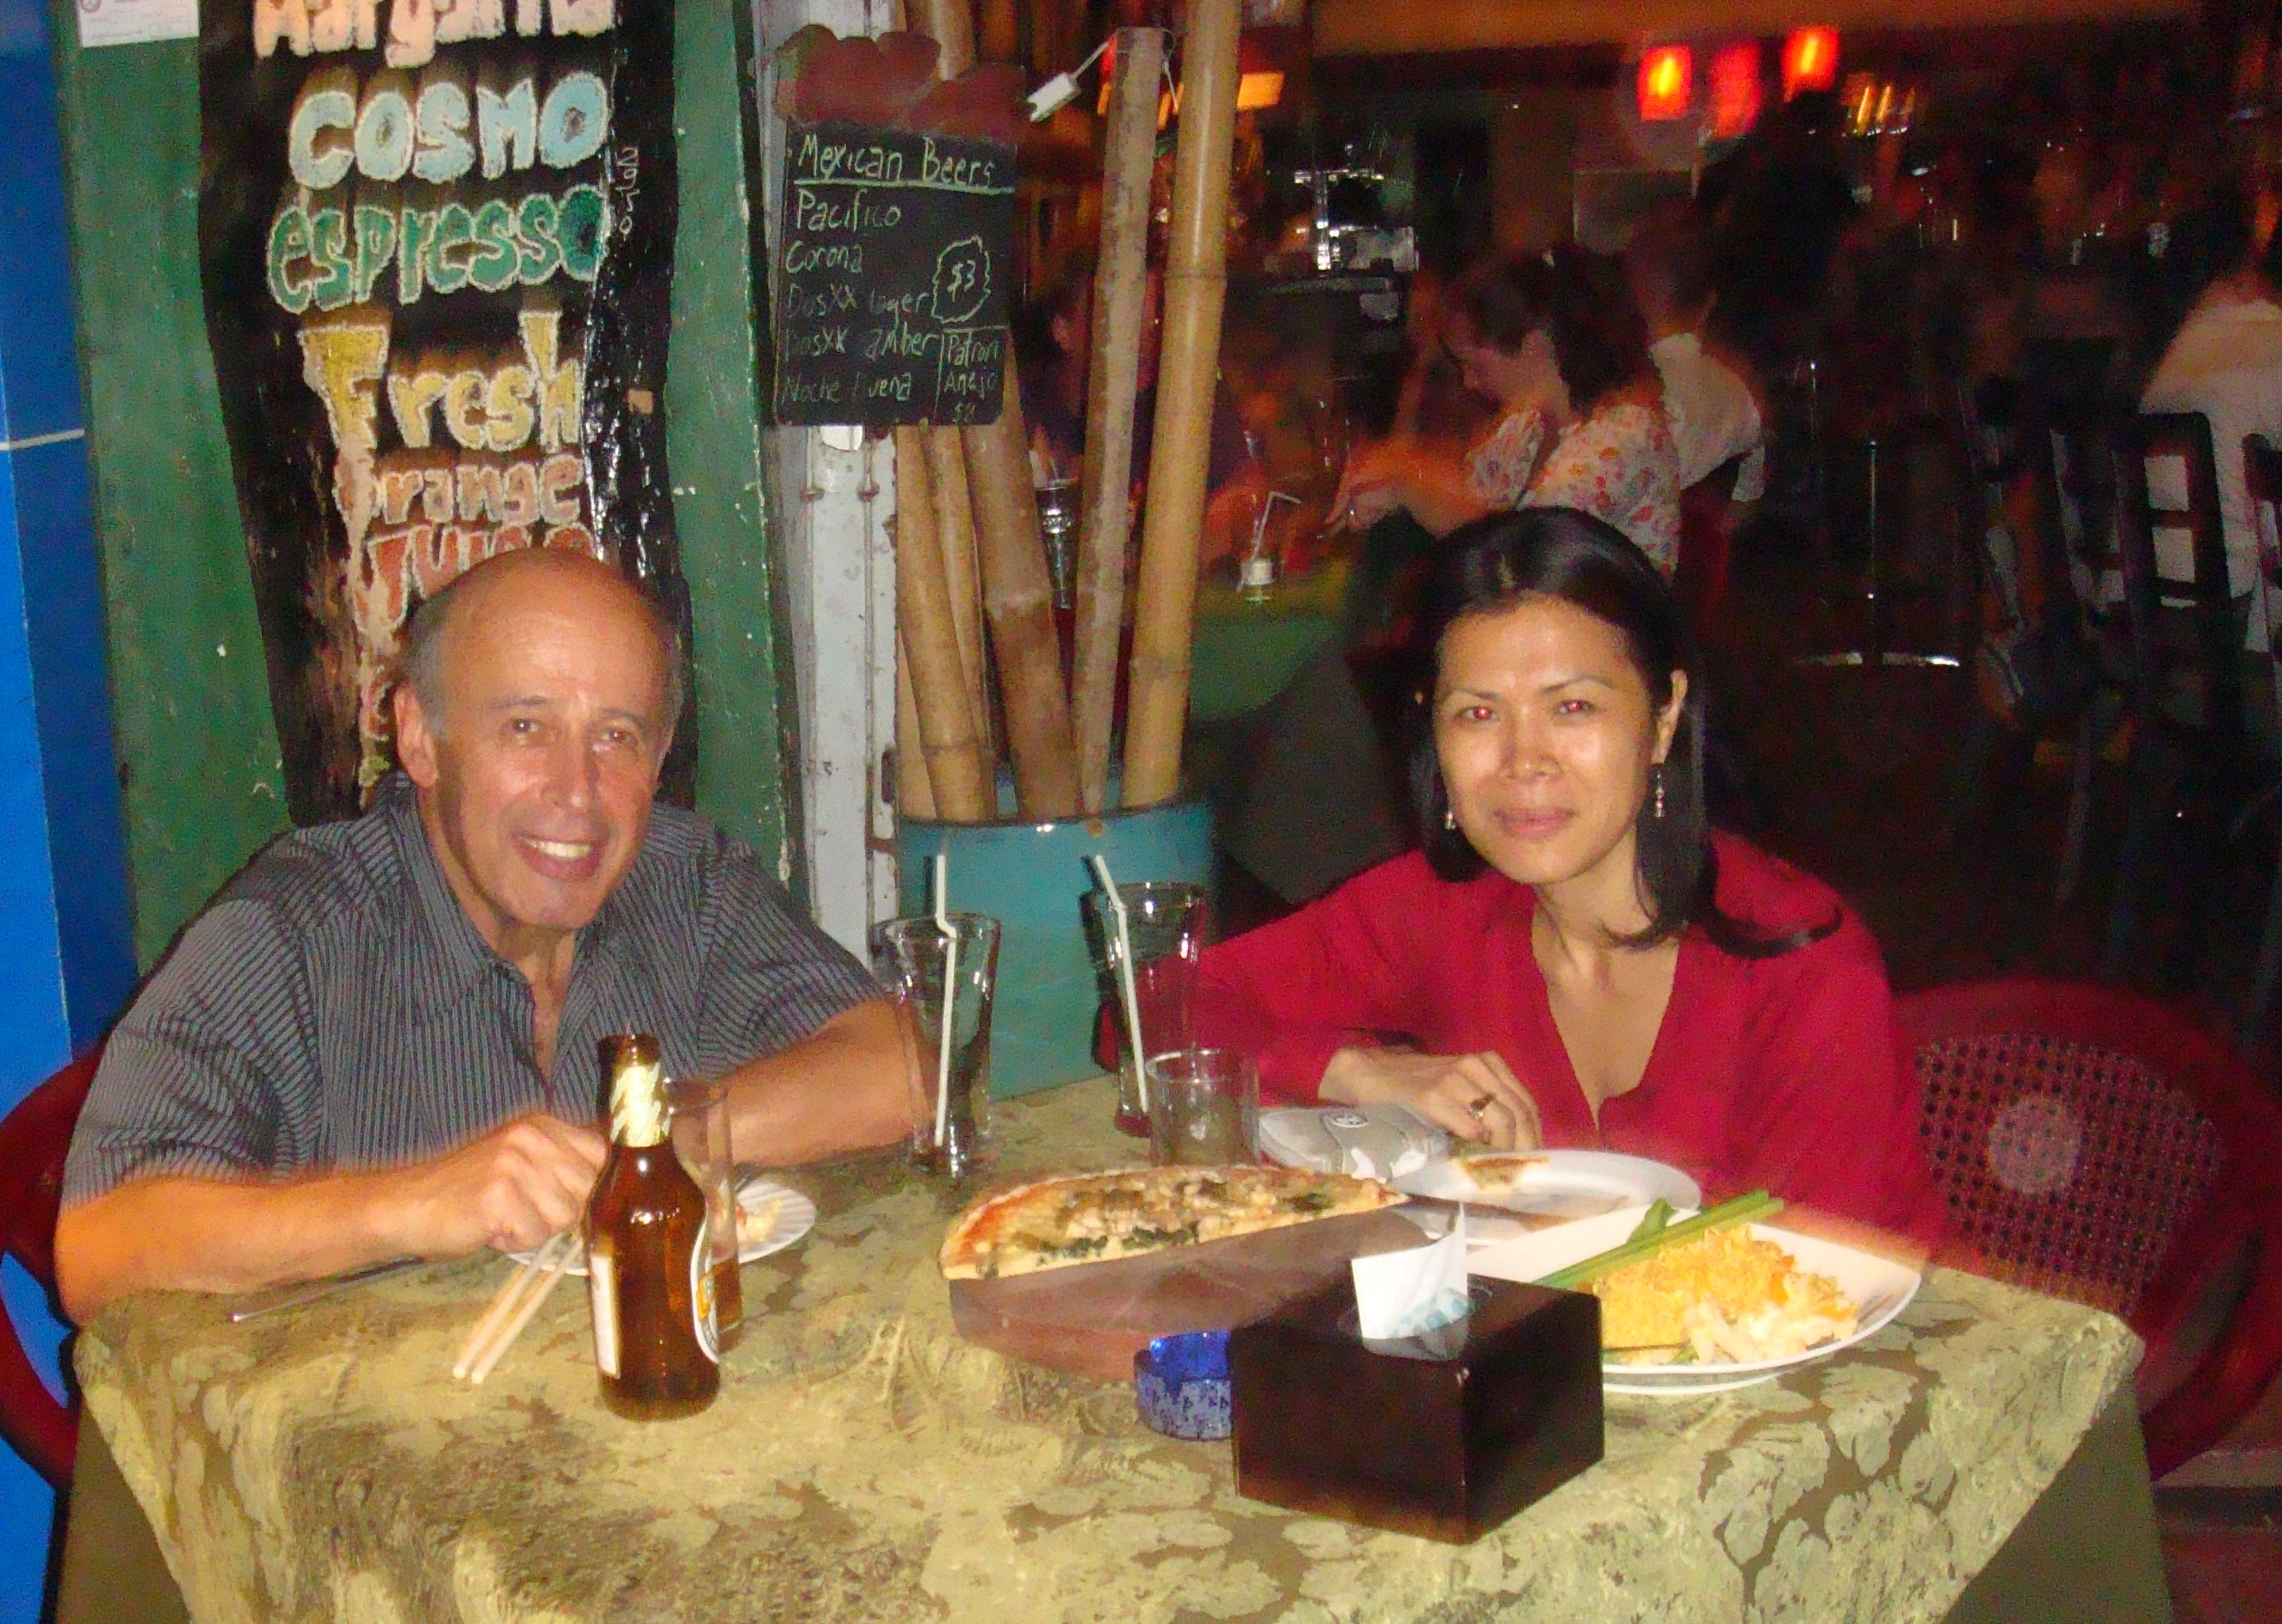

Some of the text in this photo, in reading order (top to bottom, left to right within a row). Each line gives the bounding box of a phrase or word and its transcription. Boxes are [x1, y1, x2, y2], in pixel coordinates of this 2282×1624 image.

[289, 71, 609, 188] COSMO
[797, 133, 996, 187] Mexican Beers
[268, 183, 609, 314] espresso
[796, 188, 902, 232] Pacifico
[785, 239, 863, 274] Corona
[297, 310, 584, 454] Fresh
